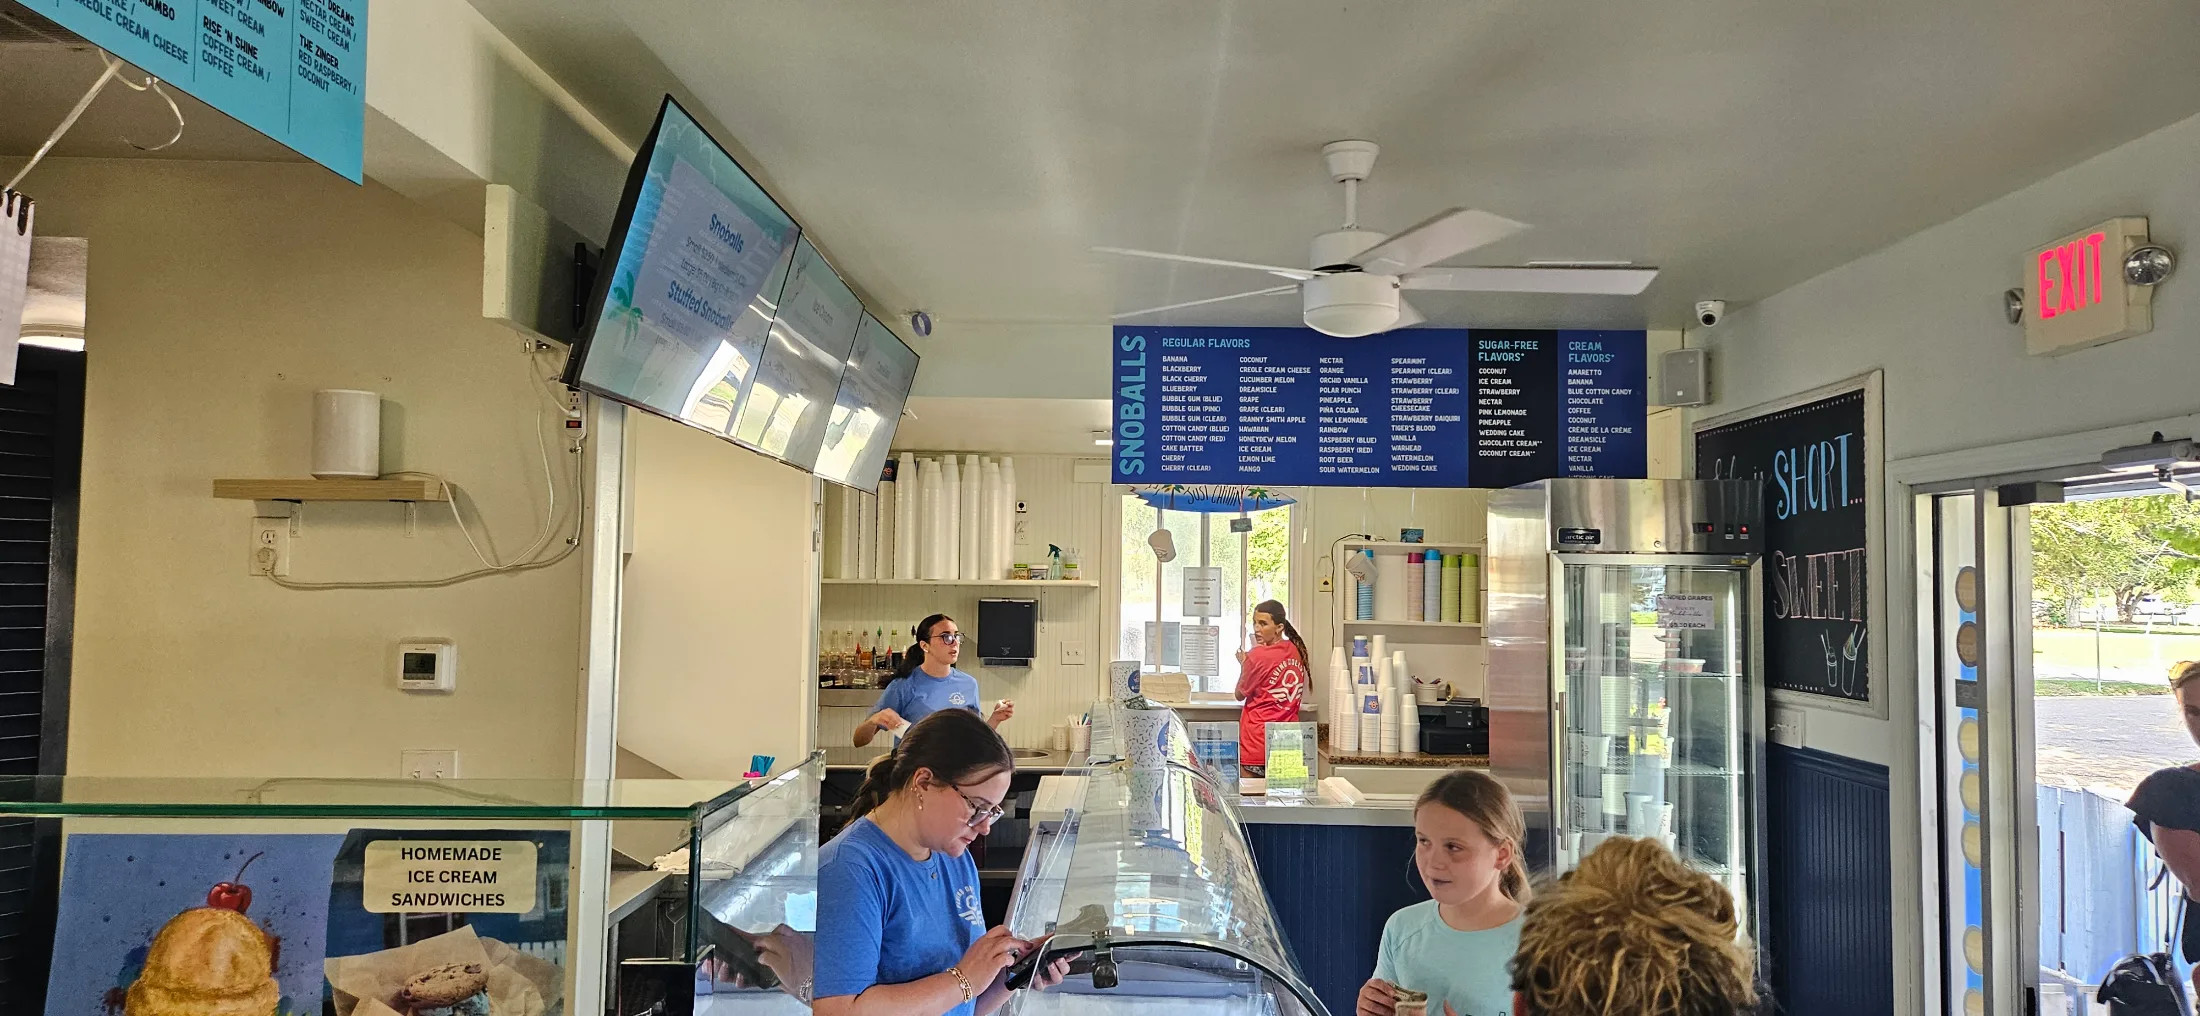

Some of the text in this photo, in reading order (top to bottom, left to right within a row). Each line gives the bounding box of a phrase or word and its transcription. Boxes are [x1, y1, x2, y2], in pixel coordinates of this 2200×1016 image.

[328, 0, 355, 27] DREAMS
[238, 10, 265, 37] CREAM
[300, 9, 350, 52] SWEET CREAM
[329, 15, 351, 39] CREAM
[116, 12, 189, 64] CREAM CHEESE
[203, 15, 223, 37] RISE
[235, 35, 259, 60] SHINE
[202, 33, 265, 80] COFFEE CREAM
[299, 33, 339, 70] THE ZINGER
[202, 50, 234, 78] COFFEE
[298, 49, 352, 92] RED RASPBERRY
[298, 64, 331, 93] COCONUT
[709, 213, 744, 254] Snoballs
[2038, 232, 2105, 320] EXIT
[668, 279, 702, 313] Stuffed
[1162, 338, 1250, 348] REGULAR FLAVORS
[1479, 340, 1538, 350] SUGAR-FREE
[1568, 341, 1602, 351] CREAM
[1391, 367, 1426, 375] SPEARMINT
[1274, 376, 1295, 384] MELON
[1391, 377, 1433, 385] STRAWBERRY
[1119, 334, 1147, 476] SNOBALLS
[1319, 416, 1334, 424] PINK
[1319, 426, 1348, 434] RAINBOW
[1600, 426, 1610, 434] LA
[1161, 434, 1186, 442] COTTON
[1478, 439, 1514, 447] CHOCOLATE
[1161, 444, 1178, 452] CAKE
[1356, 446, 1373, 454] (RED)
[1391, 444, 1422, 452] WARHEAD
[1261, 455, 1276, 463] LIME
[1391, 454, 1434, 462] WATERMELON
[1238, 465, 1261, 473] MANGO
[1772, 548, 1866, 623] SWEET
[401, 847, 502, 861] HOMEMADE
[407, 869, 498, 884] ICE CREAM
[391, 892, 506, 908] SANDWICHES
